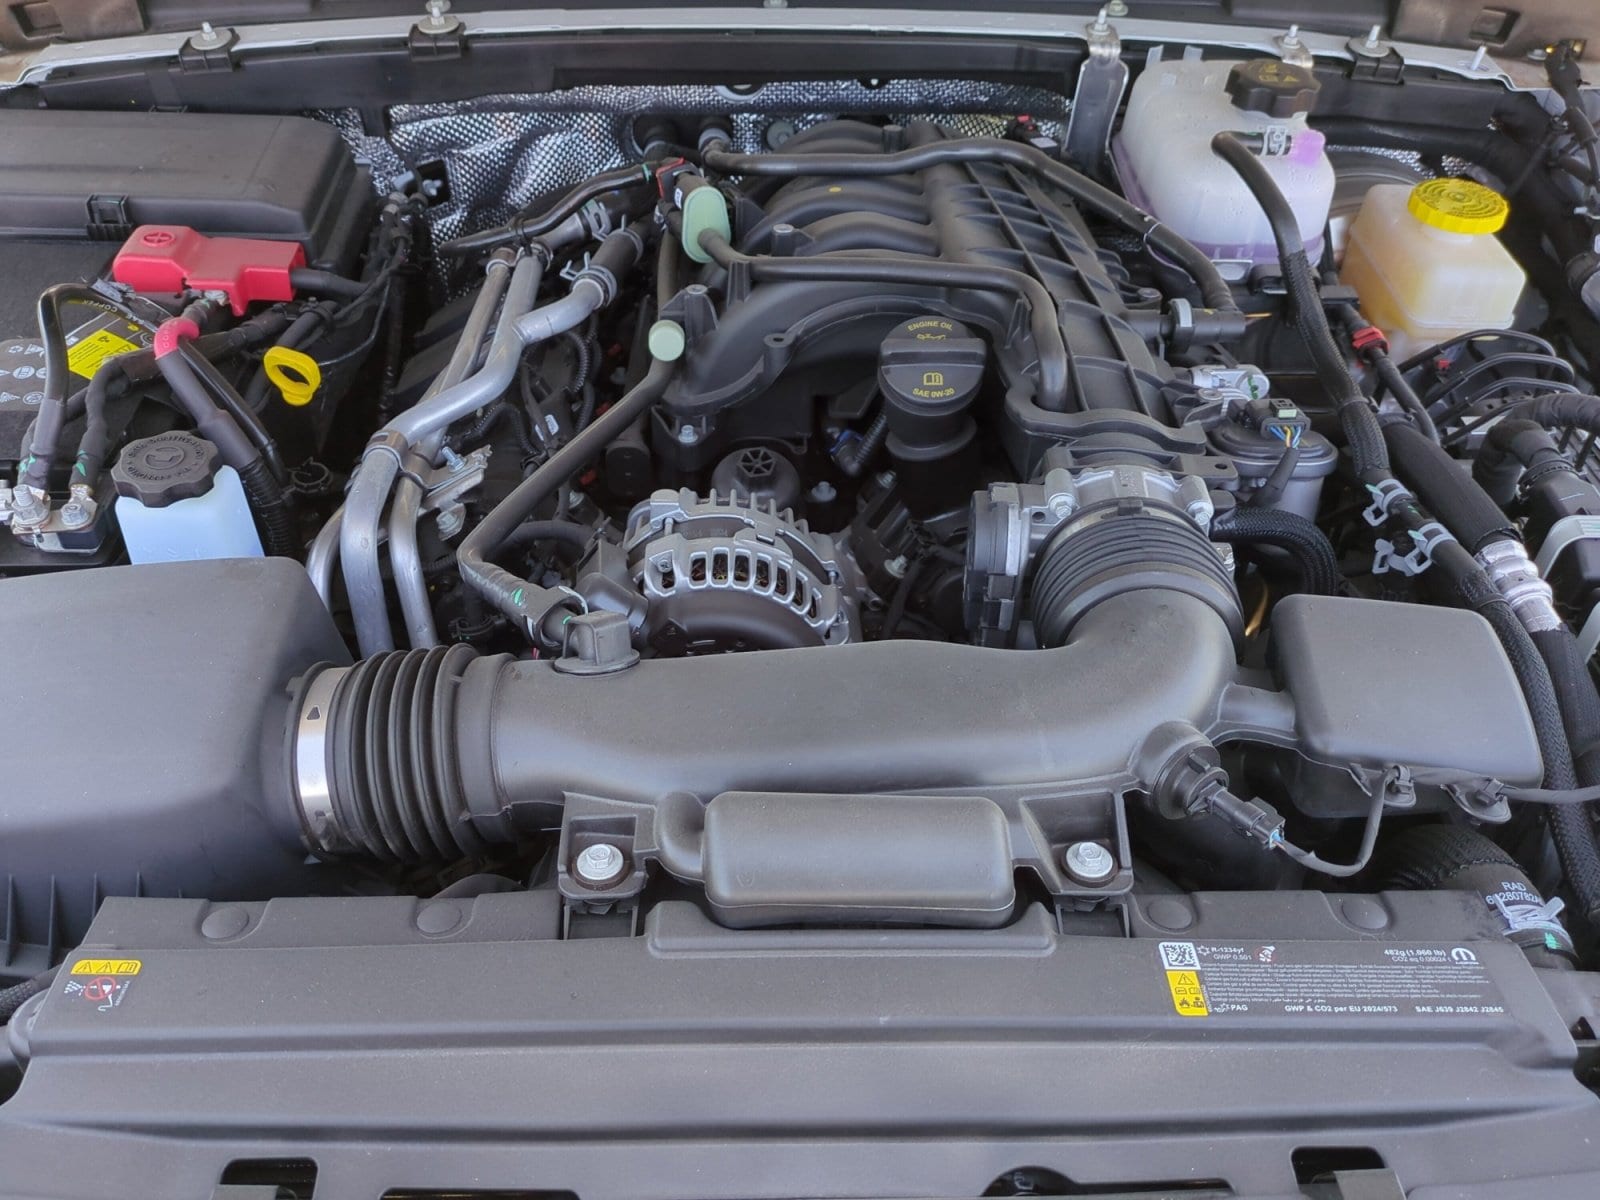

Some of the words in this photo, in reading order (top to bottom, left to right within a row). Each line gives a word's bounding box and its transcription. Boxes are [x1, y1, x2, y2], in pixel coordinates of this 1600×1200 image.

[908, 321, 939, 331] ENGINE
[940, 321, 953, 331] OIL
[912, 387, 929, 398] SAE
[930, 387, 955, 398] 0W-20
[1501, 881, 1527, 891] RAD
[1433, 949, 1446, 957] lb)
